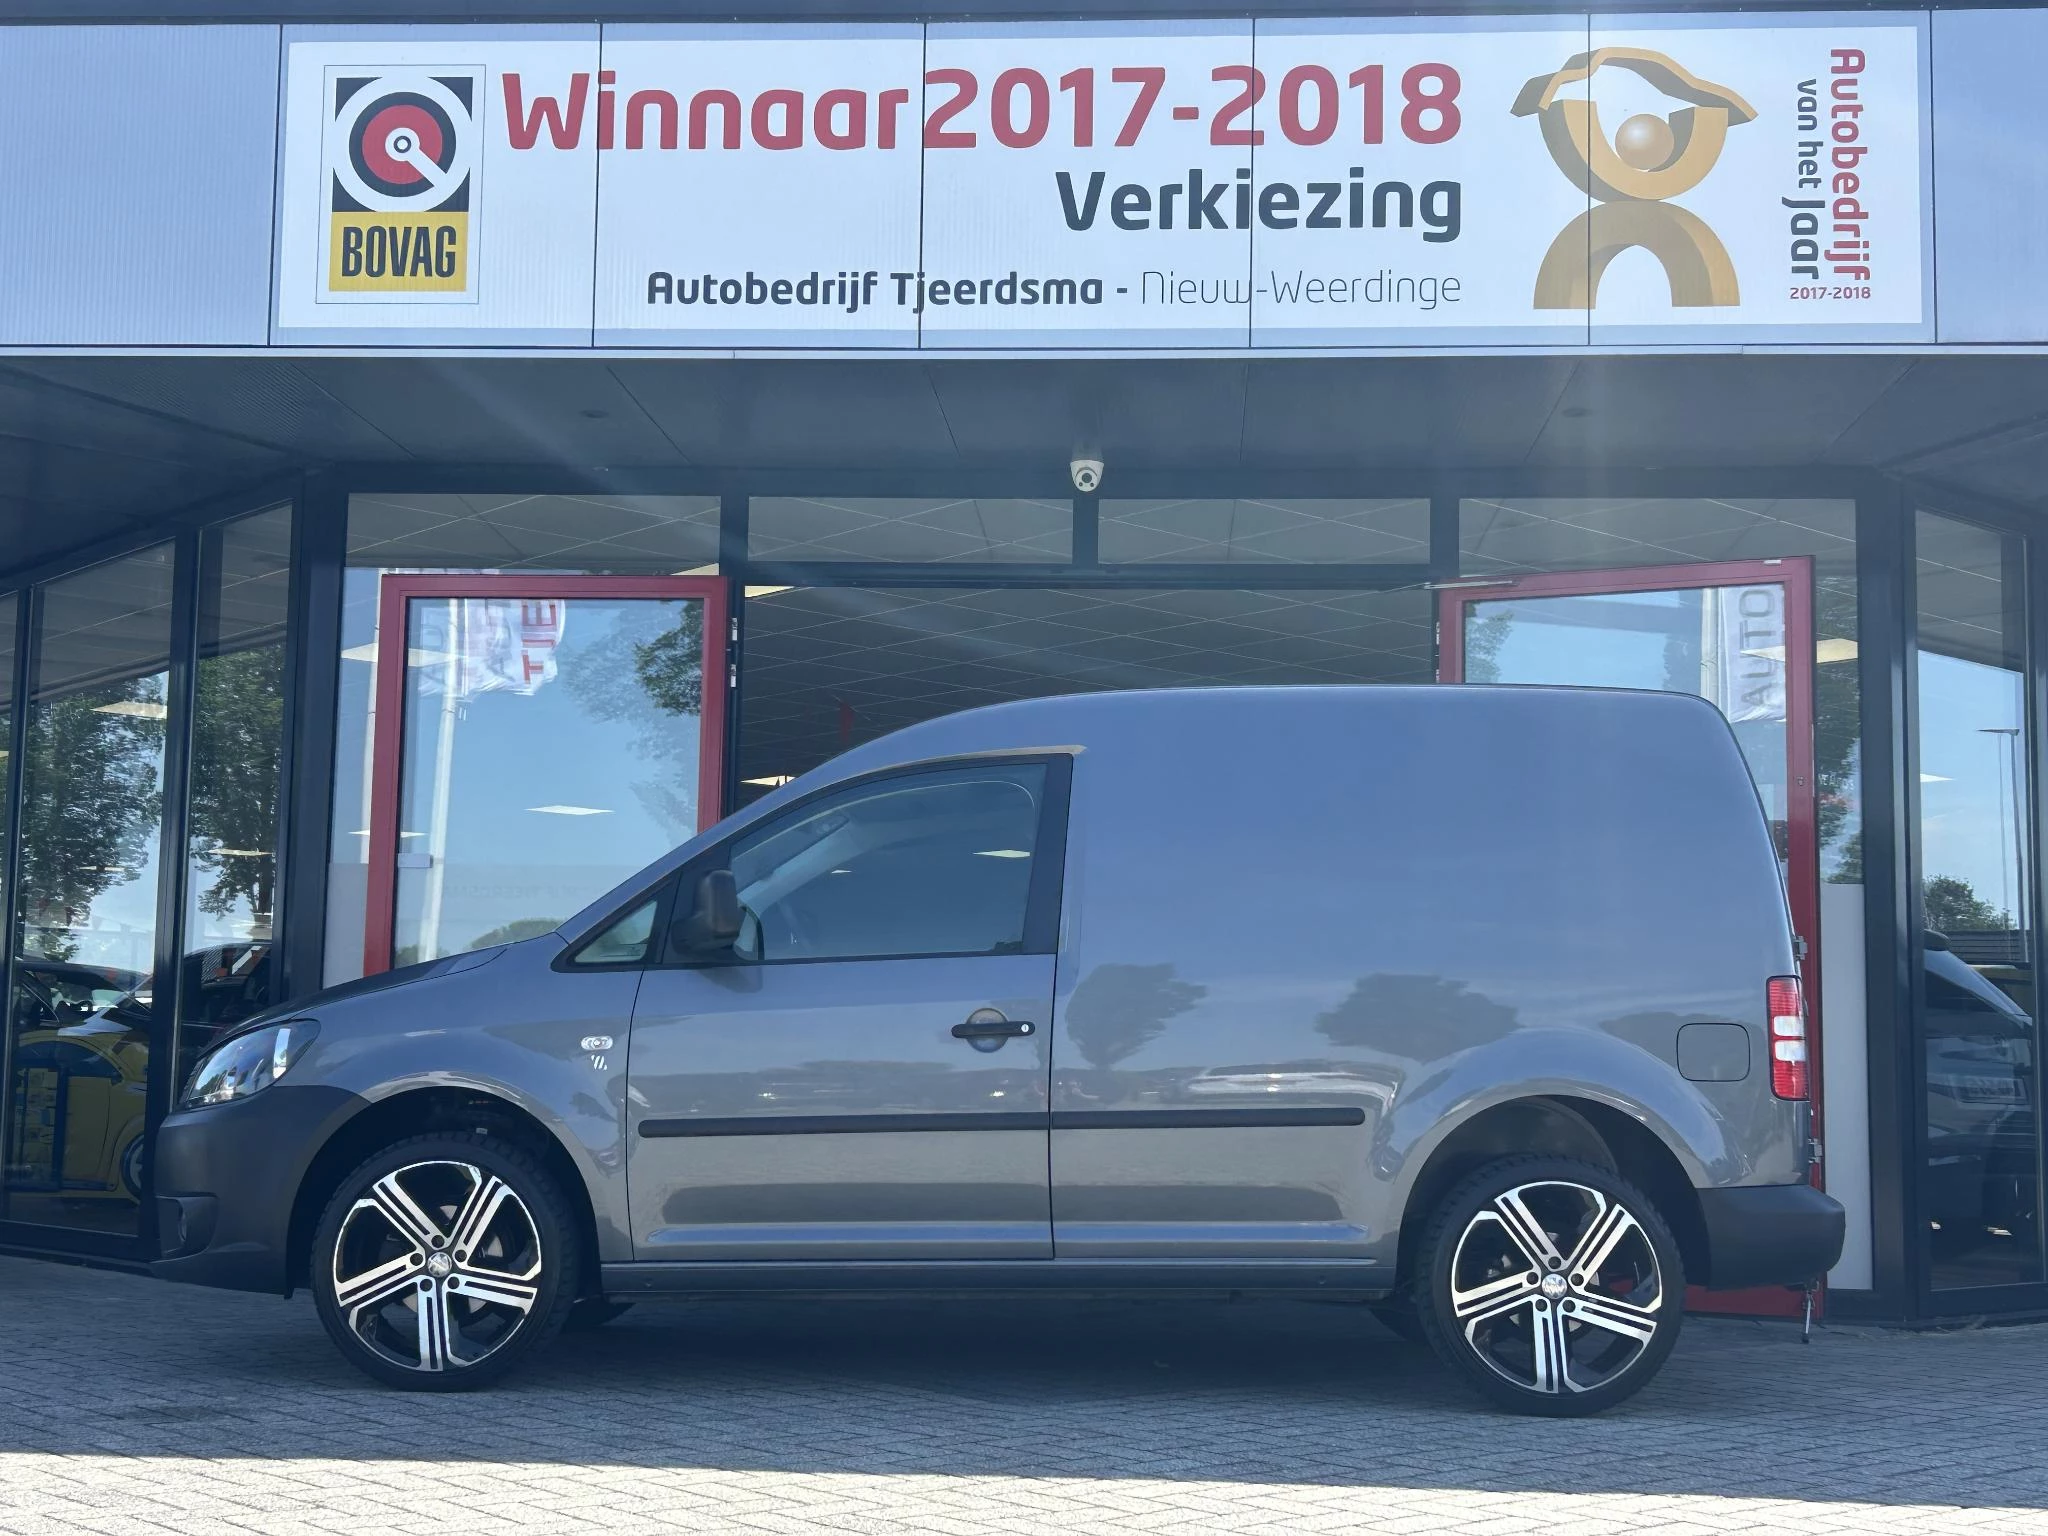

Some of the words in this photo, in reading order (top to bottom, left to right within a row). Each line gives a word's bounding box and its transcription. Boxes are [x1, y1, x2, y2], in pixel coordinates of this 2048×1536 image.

[501, 70, 909, 150] Winnaar
[923, 63, 1461, 148] 2017-2018
[1797, 79, 1817, 130] van
[1798, 141, 1823, 188] het
[1824, 49, 1871, 280] Autobedrijf
[1056, 167, 1461, 242] Verkiezing
[341, 226, 456, 278] BOVAG
[1781, 197, 1826, 280] Jaar
[647, 271, 878, 314] Autobedrijf
[890, 270, 1103, 315] Tjeerdsma
[1142, 269, 1461, 310] Nieuw-Weerdinge
[1790, 287, 1871, 299] 2017-2018
